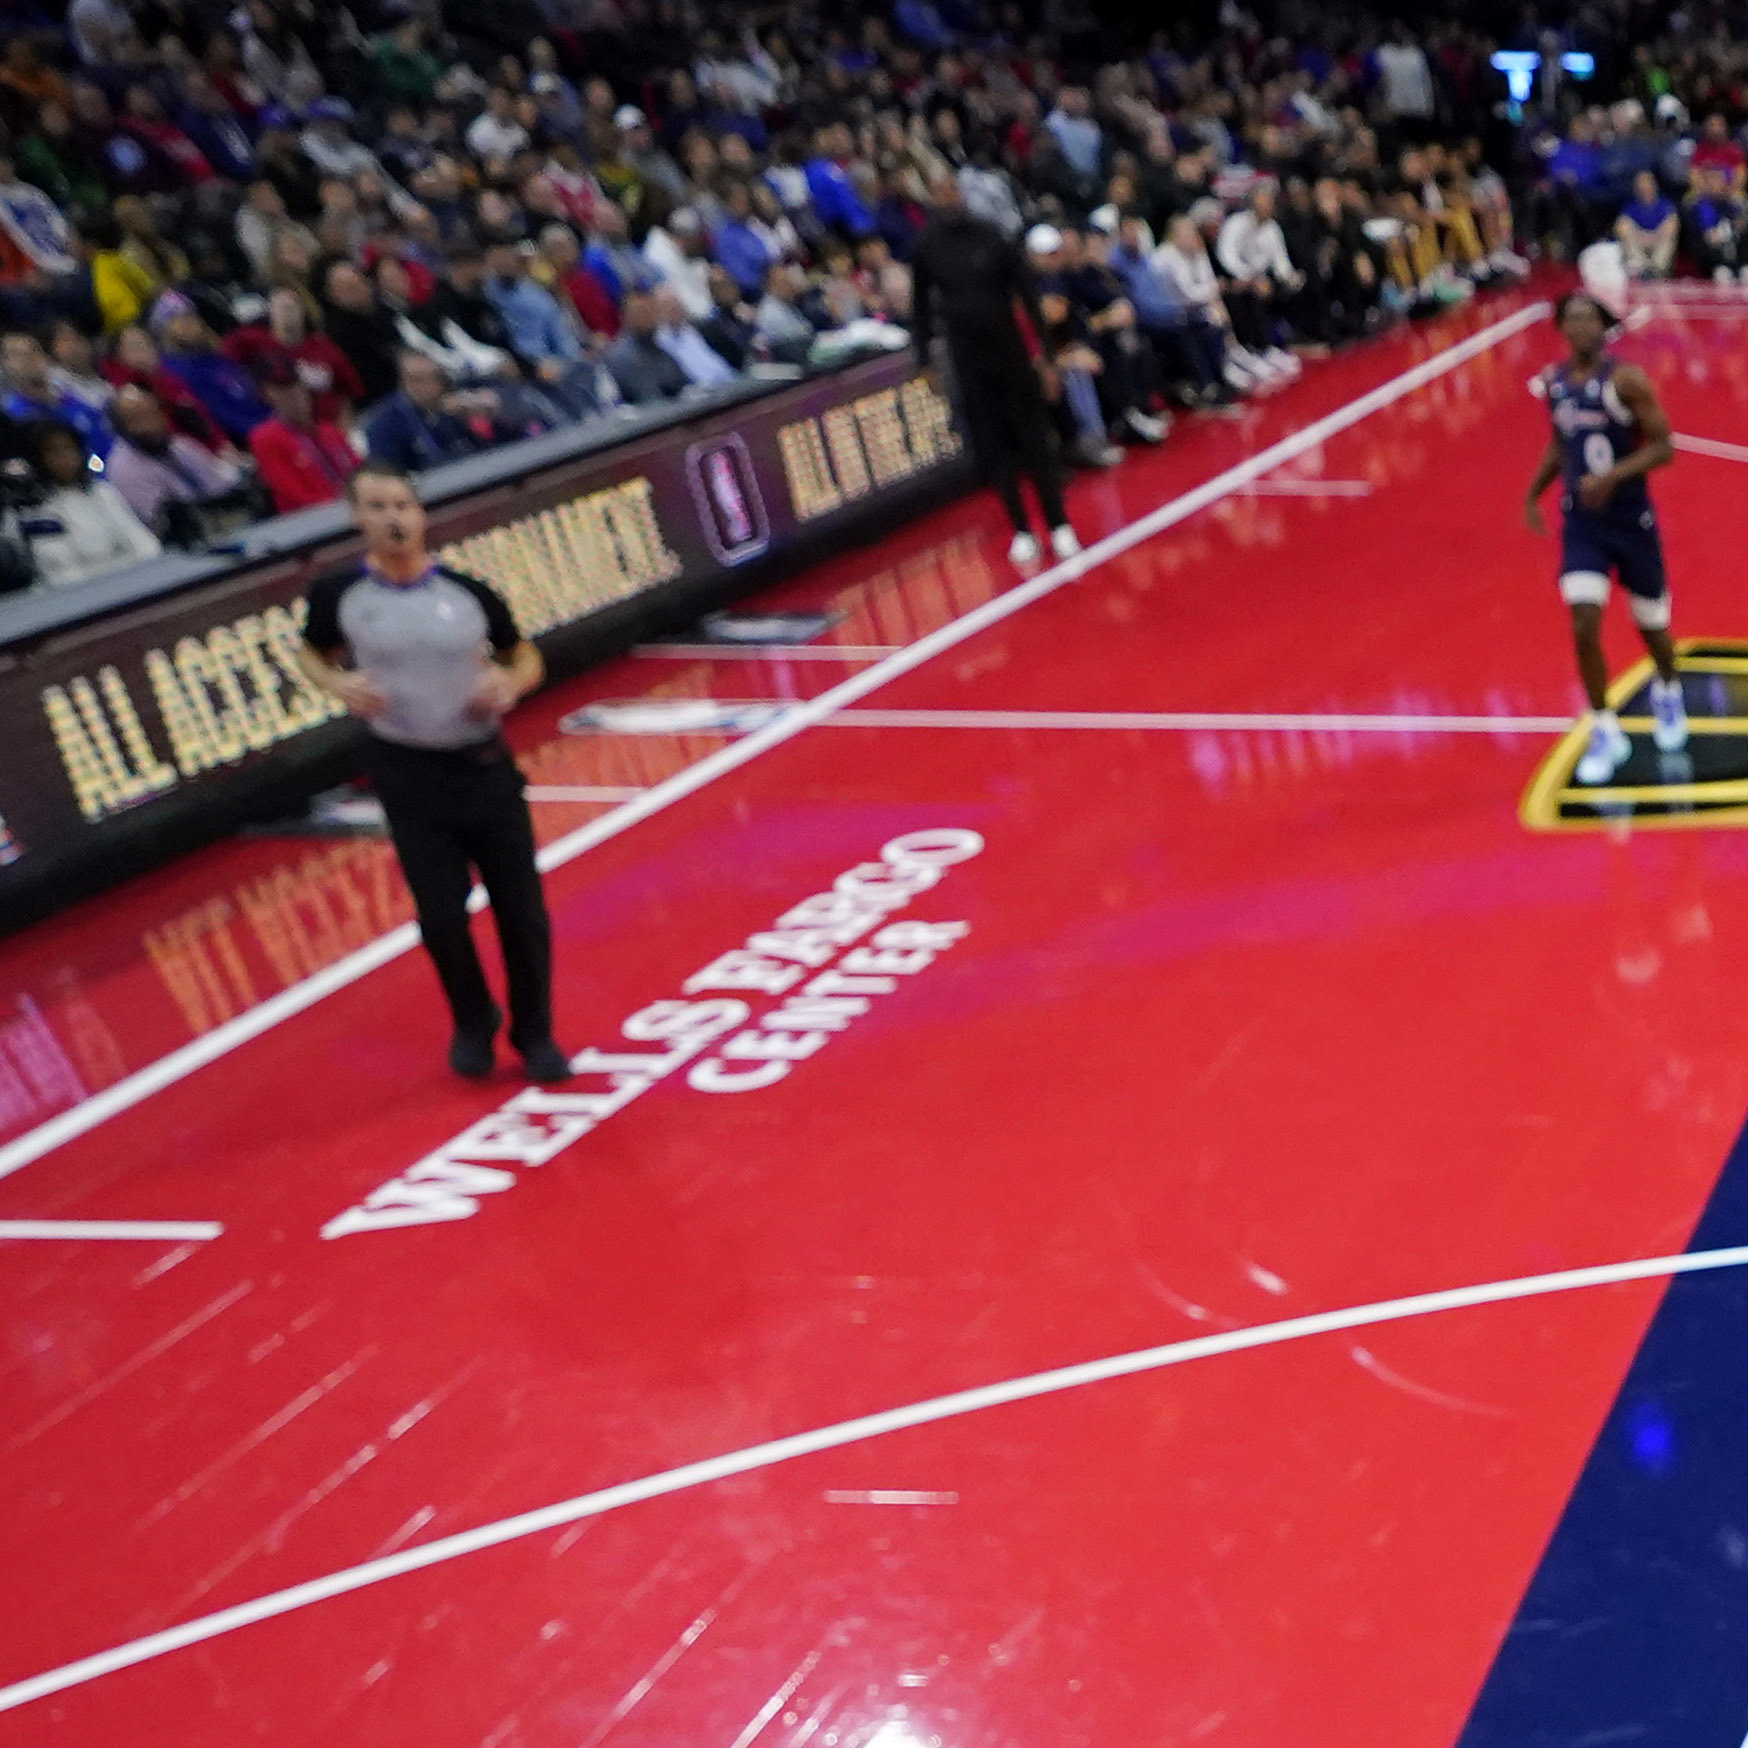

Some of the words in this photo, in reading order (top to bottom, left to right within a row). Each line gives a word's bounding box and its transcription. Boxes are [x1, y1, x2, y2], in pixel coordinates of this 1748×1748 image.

[42, 663, 179, 825] ALL
[686, 919, 971, 1094] CENTER
[320, 998, 751, 1240] WELLS
